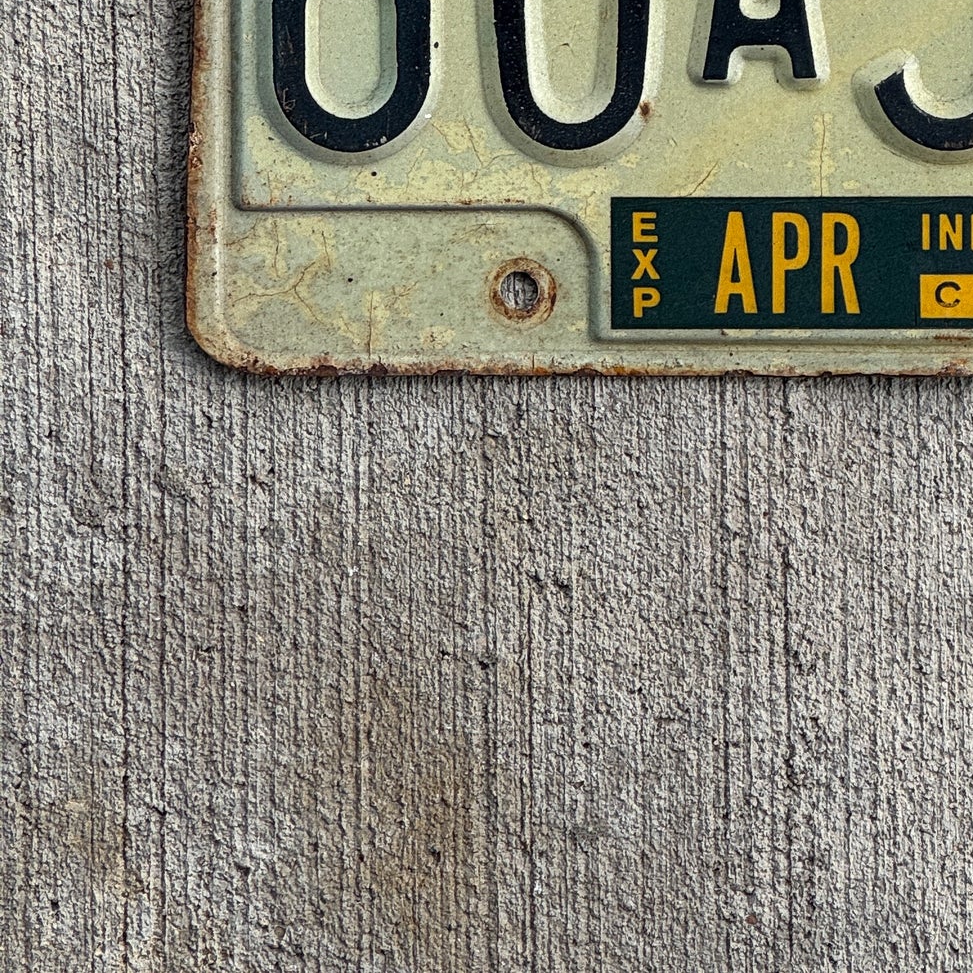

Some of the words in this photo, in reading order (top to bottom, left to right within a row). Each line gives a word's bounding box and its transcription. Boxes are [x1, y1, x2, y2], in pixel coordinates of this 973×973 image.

[631, 211, 661, 318] EXP
[714, 211, 861, 314] APR
[935, 281, 961, 308] C
